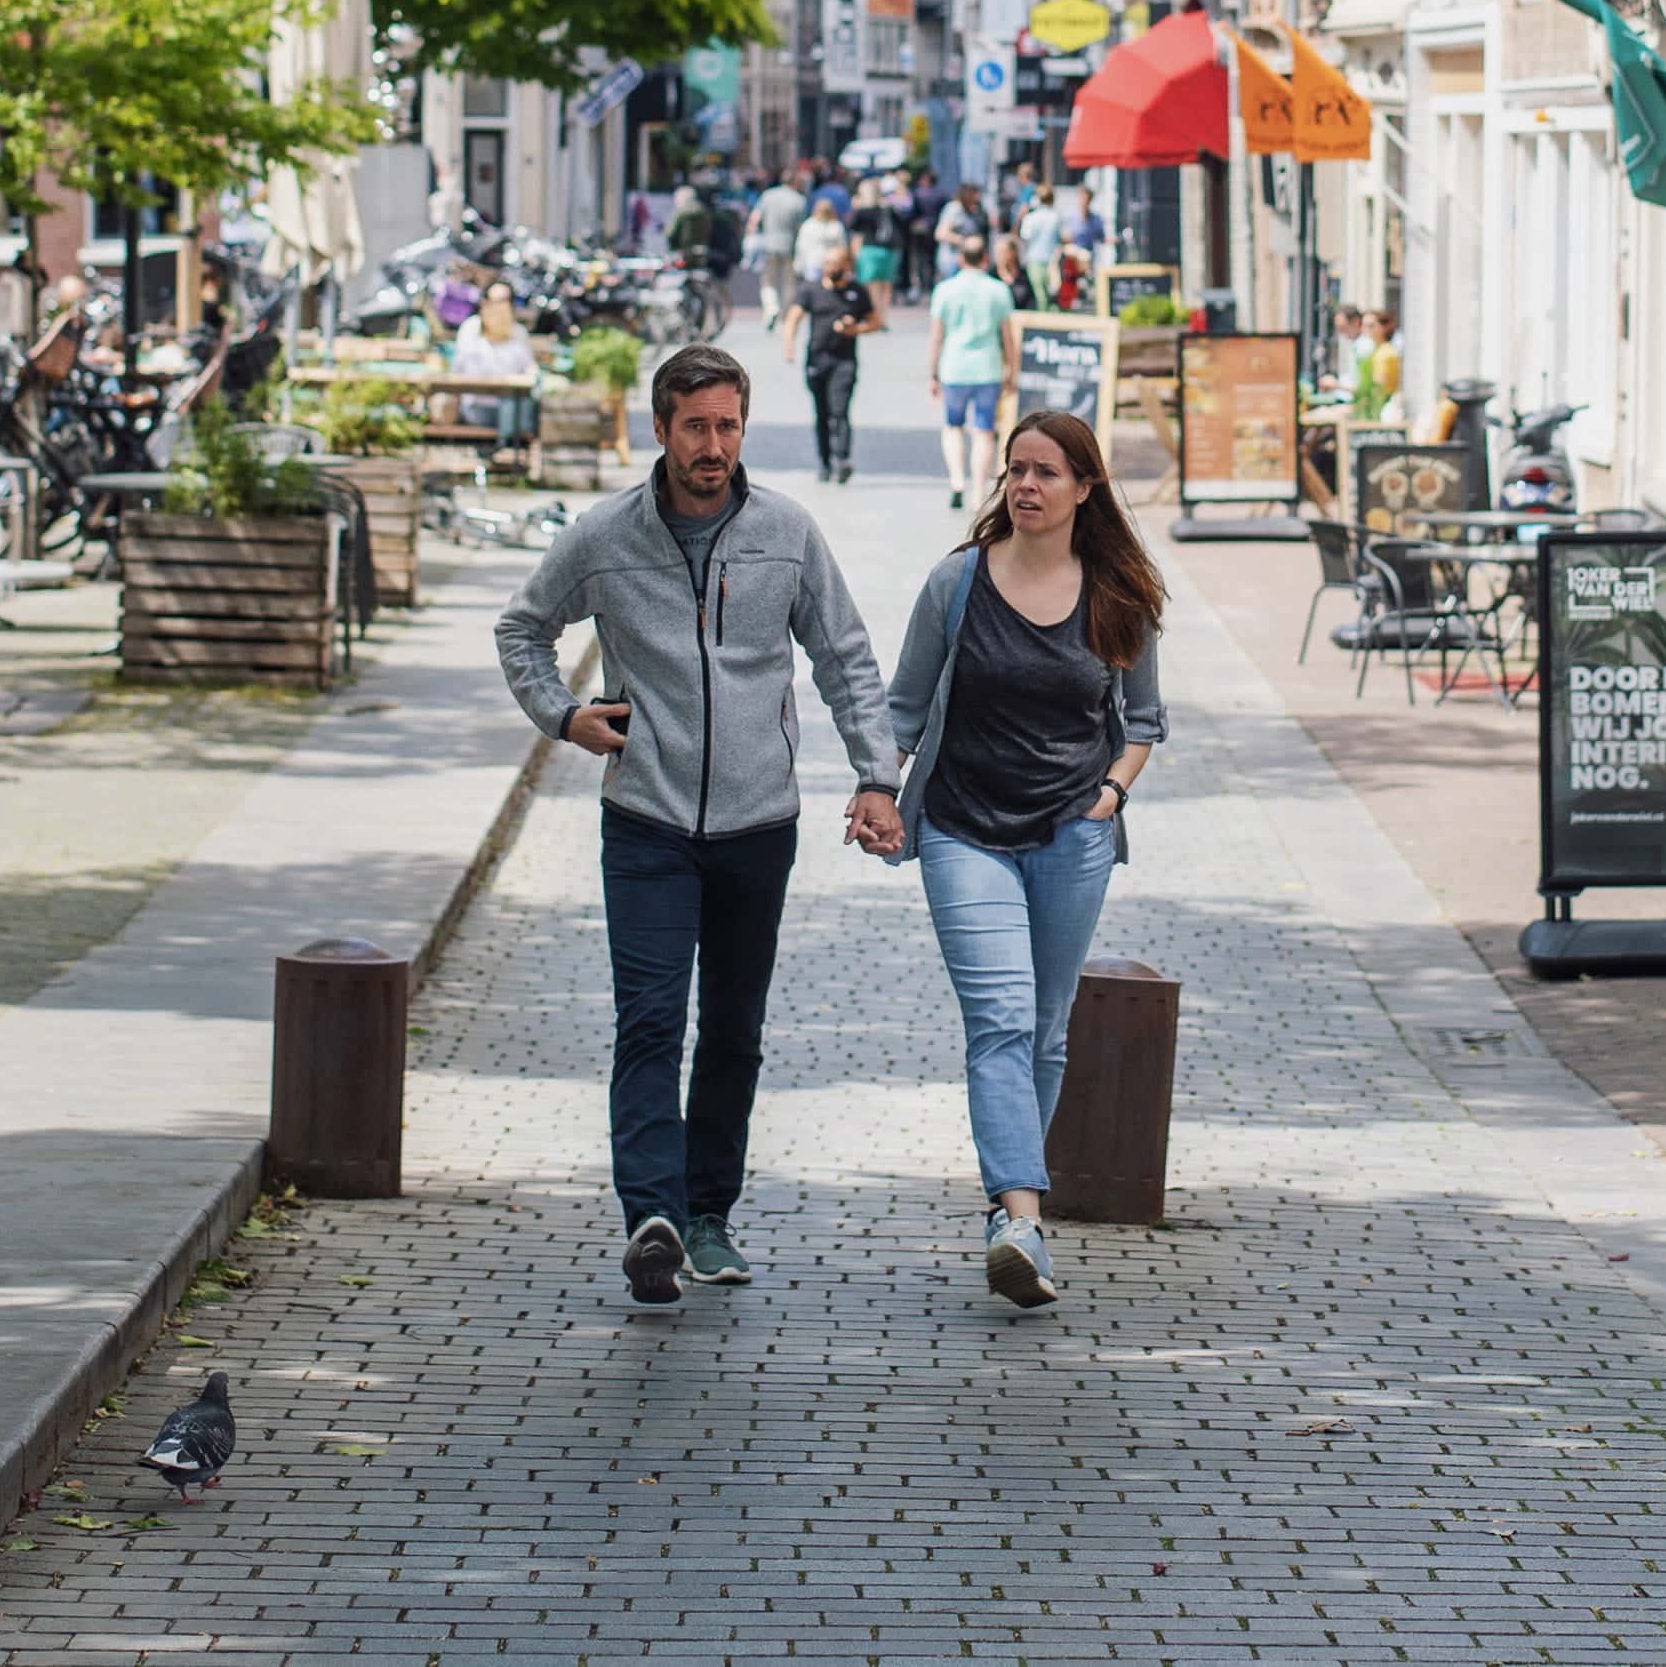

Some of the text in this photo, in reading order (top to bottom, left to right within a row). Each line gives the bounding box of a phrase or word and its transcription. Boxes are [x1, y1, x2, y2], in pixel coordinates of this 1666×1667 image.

[1567, 567, 1621, 582] JOKER
[1575, 581, 1648, 597] VAN DER
[1611, 597, 1653, 612] WIEL
[1570, 666, 1660, 690] DOOR
[1571, 715, 1630, 739] WIJ
[1570, 765, 1649, 790] NOG.
